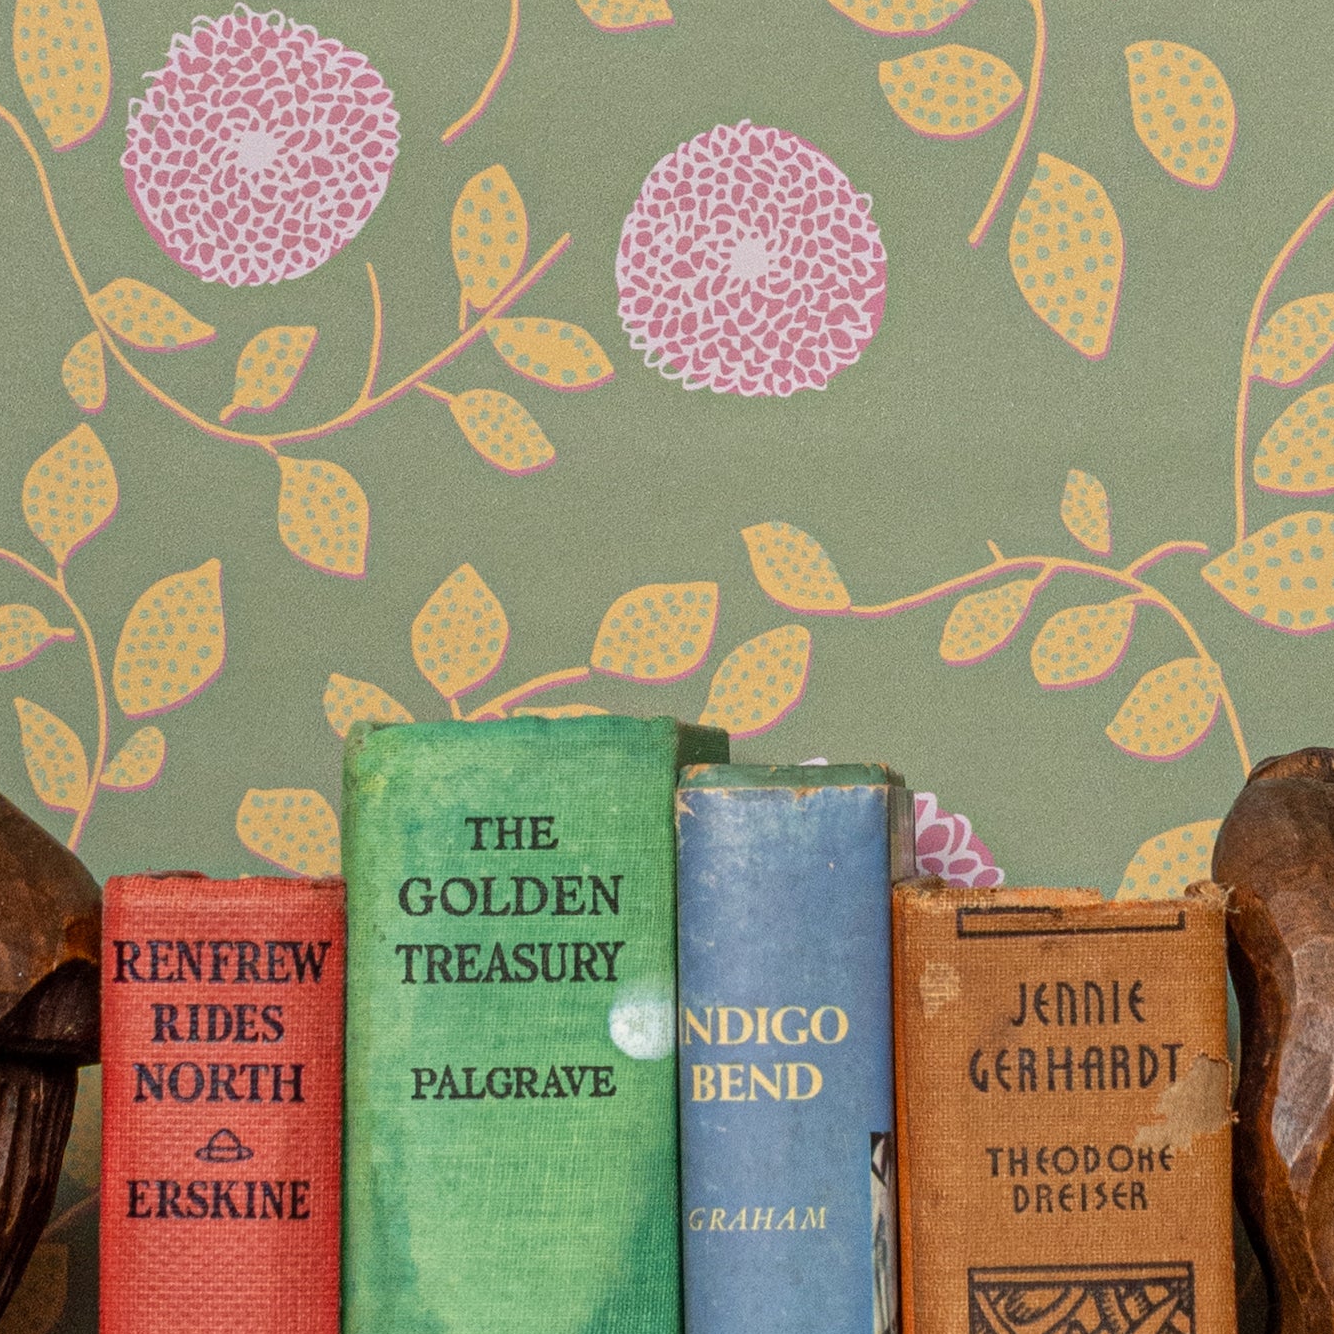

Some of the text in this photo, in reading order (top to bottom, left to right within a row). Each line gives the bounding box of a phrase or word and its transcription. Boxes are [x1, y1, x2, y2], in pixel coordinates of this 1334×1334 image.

[465, 816, 559, 851] THE
[398, 875, 624, 917] GOLDEN
[112, 940, 332, 985] RENFREW
[395, 941, 625, 984] TREASURY
[1011, 980, 1145, 1027] JENNIE
[151, 1004, 285, 1044] RIDES
[678, 1005, 849, 1045] NDIGO
[133, 1062, 305, 1104] NORTH
[411, 1065, 617, 1100] PALGRAVE
[691, 1062, 823, 1102] BEND
[969, 1043, 1183, 1093] GERHARDT
[127, 1180, 310, 1220] ERSKINE
[1013, 1182, 1147, 1213] DREISER
[689, 1206, 826, 1231] GRAHAM
